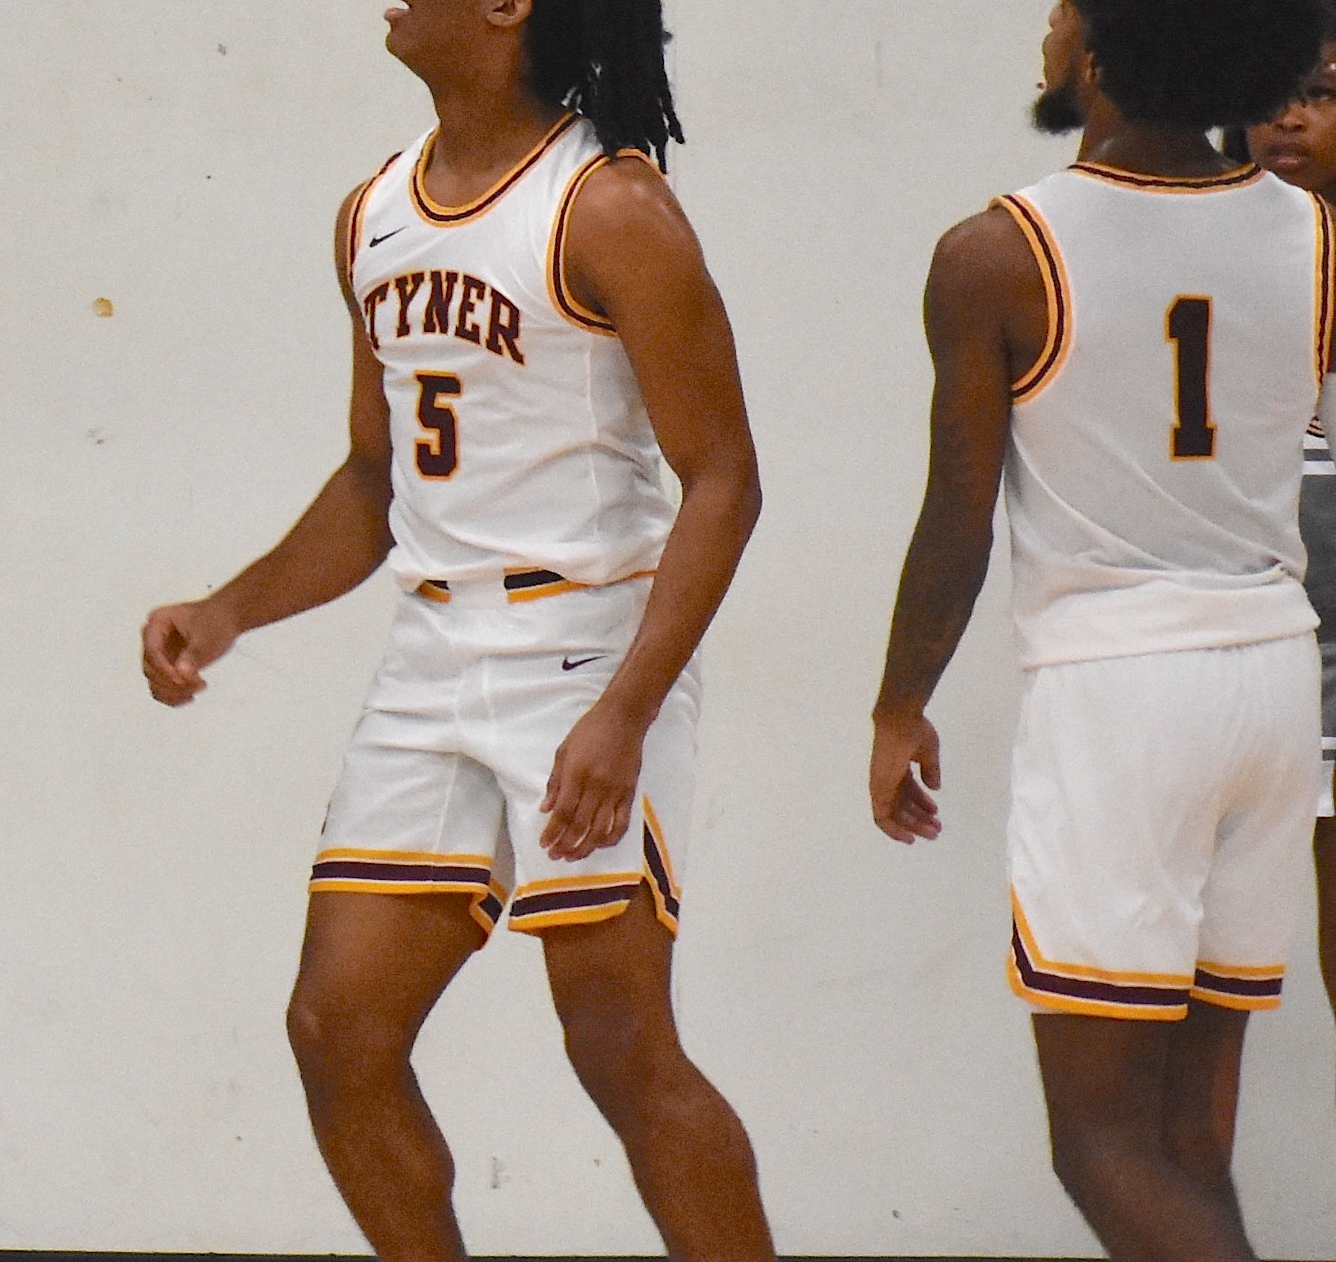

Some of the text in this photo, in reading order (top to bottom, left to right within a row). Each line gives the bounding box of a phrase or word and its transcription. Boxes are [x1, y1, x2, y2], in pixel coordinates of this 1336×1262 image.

[363, 270, 525, 366] TYNER
[413, 369, 463, 481] 5
[1165, 294, 1217, 461] 1
